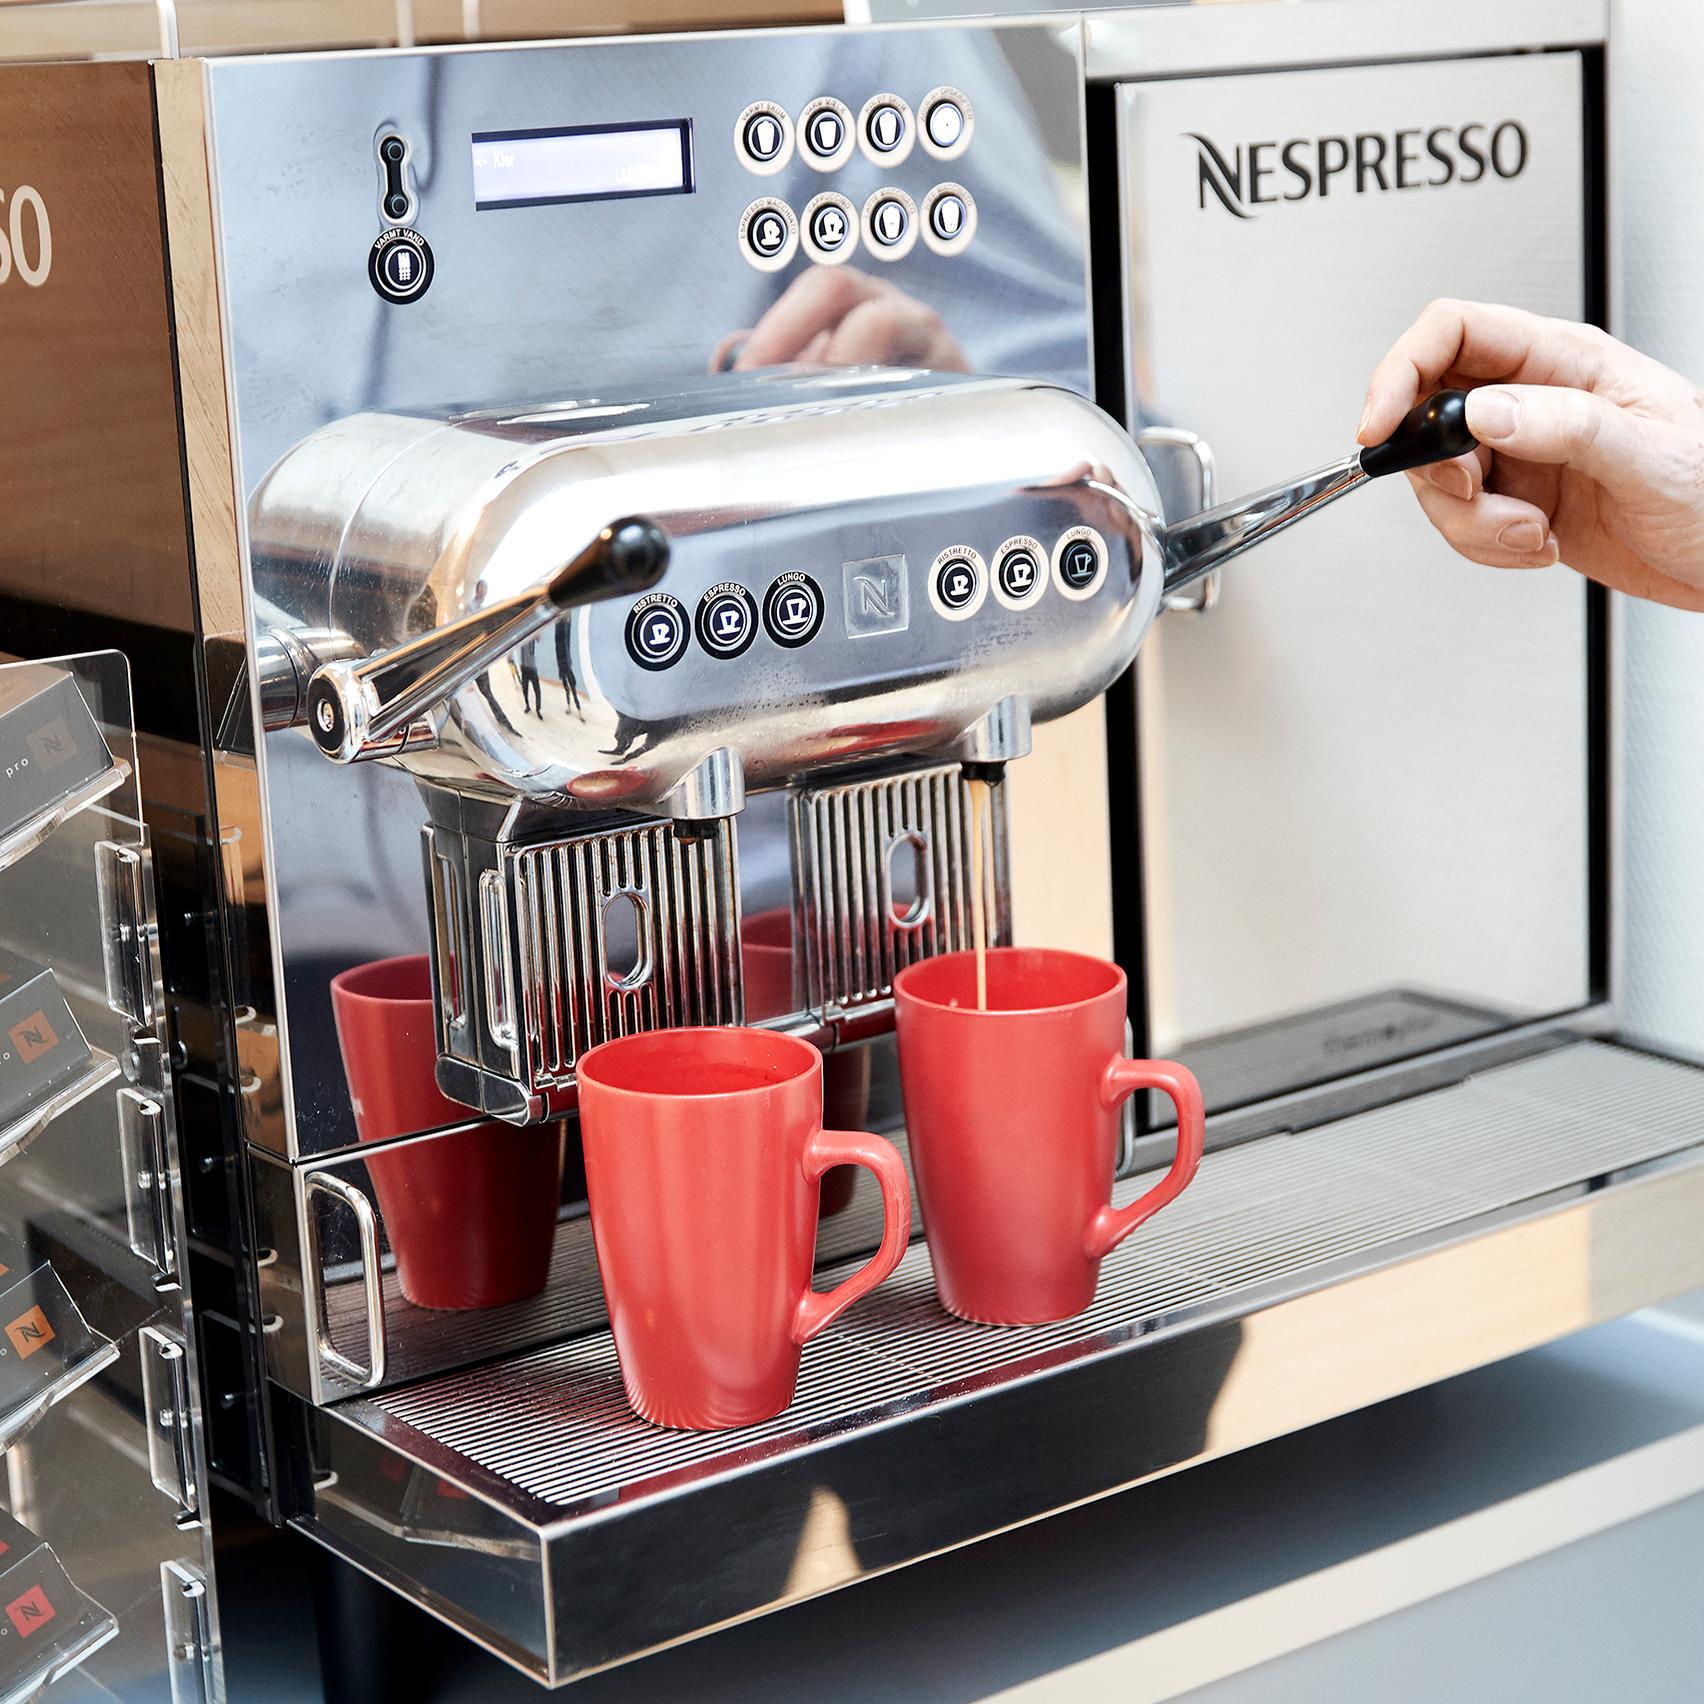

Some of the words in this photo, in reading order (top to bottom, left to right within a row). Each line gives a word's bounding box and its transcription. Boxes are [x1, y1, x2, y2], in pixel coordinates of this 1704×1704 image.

[766, 103, 786, 120] SKUM
[1178, 117, 1531, 219] NESPRESSO
[766, 198, 798, 235] MACCHIATO
[374, 228, 401, 250] VARMT
[403, 228, 425, 247] VAND
[1066, 528, 1092, 540] LUNGO
[937, 547, 978, 565] RISTRETTO
[1000, 537, 1038, 555] ESPRESSO
[777, 572, 806, 587] LUNGO
[703, 583, 747, 603] ESPRESSO
[633, 593, 679, 614] RISTRETTO
[5, 757, 29, 779] pro
